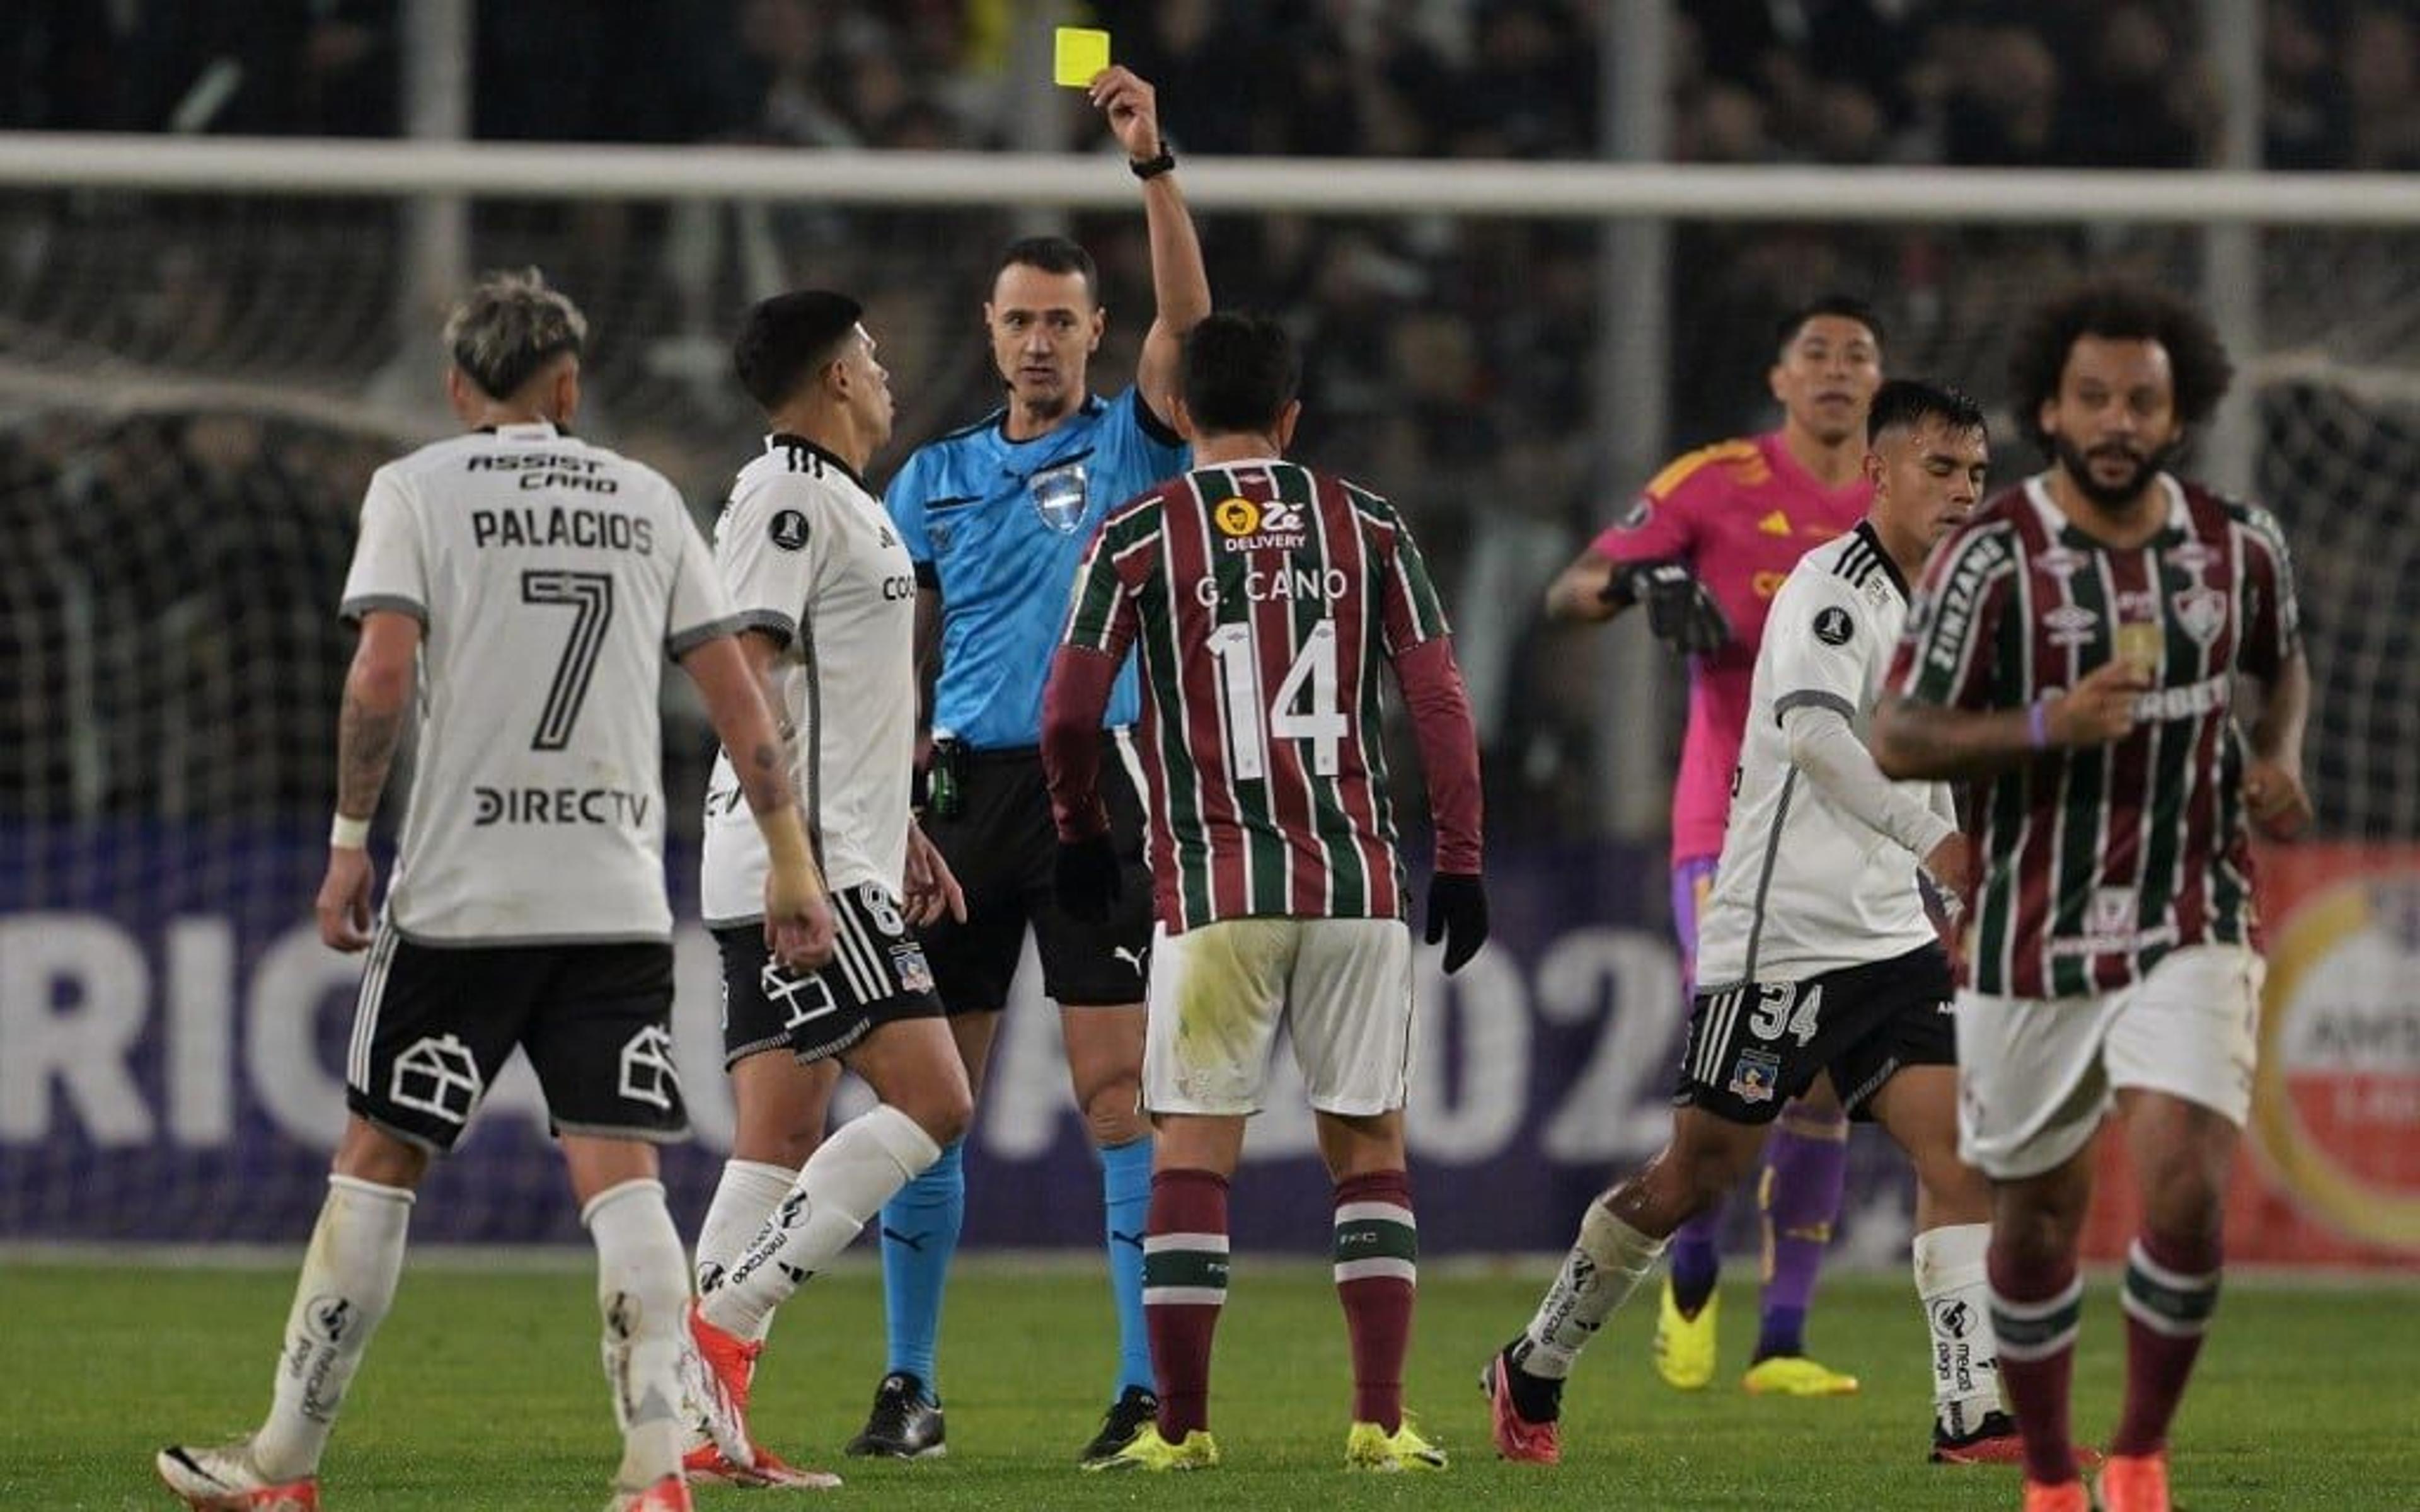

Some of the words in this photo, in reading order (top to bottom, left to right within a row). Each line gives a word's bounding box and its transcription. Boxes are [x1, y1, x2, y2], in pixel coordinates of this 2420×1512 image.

[466, 452, 605, 474] ASSIST
[519, 472, 618, 495] CARD
[472, 507, 653, 555] PALACIOS
[1225, 534, 1306, 552] DELIVERY
[1196, 576, 1228, 607] G.
[1245, 568, 1347, 601] CANO
[521, 570, 613, 752] 7
[1205, 619, 1348, 781] 14
[474, 786, 650, 827] DIRECTV
[860, 879, 905, 936] 8
[1749, 980, 1824, 1047] 34
